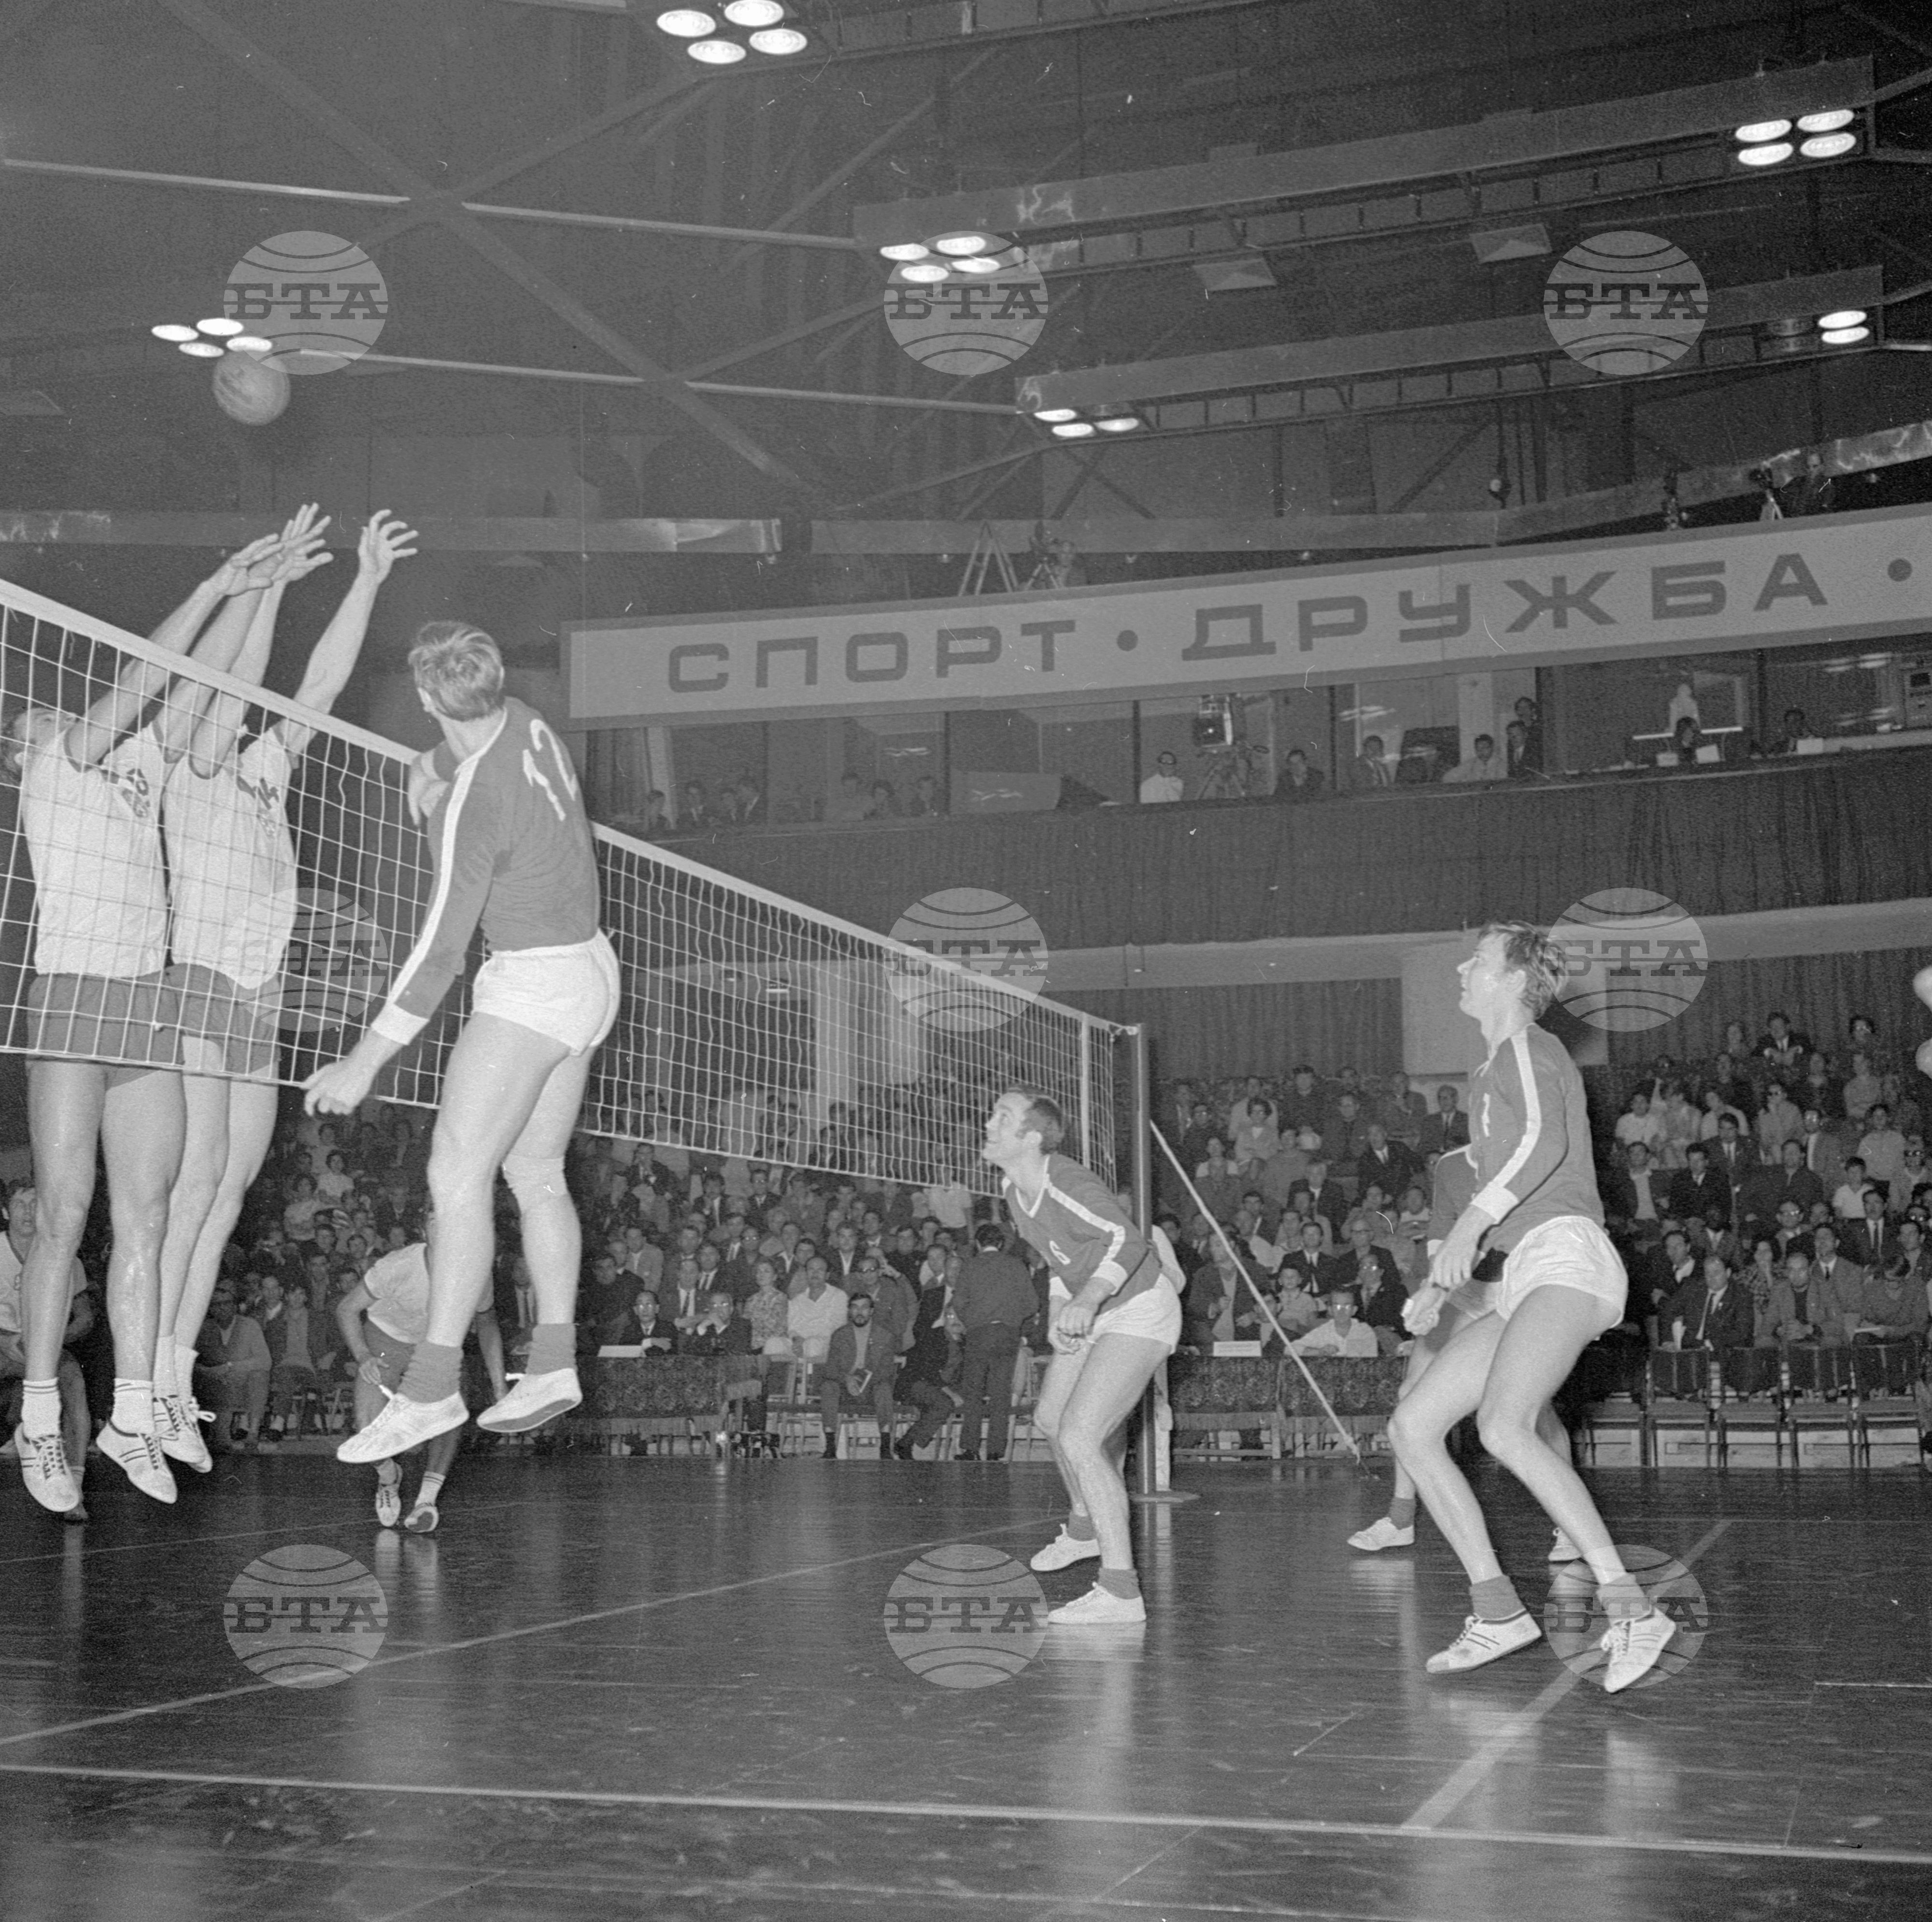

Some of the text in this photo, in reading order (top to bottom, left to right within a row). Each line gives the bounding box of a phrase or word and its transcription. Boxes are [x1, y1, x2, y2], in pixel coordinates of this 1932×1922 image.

[668, 552, 1829, 693] СПОРТ ДРУЖБА
[1049, 1240, 1071, 1265] 6
